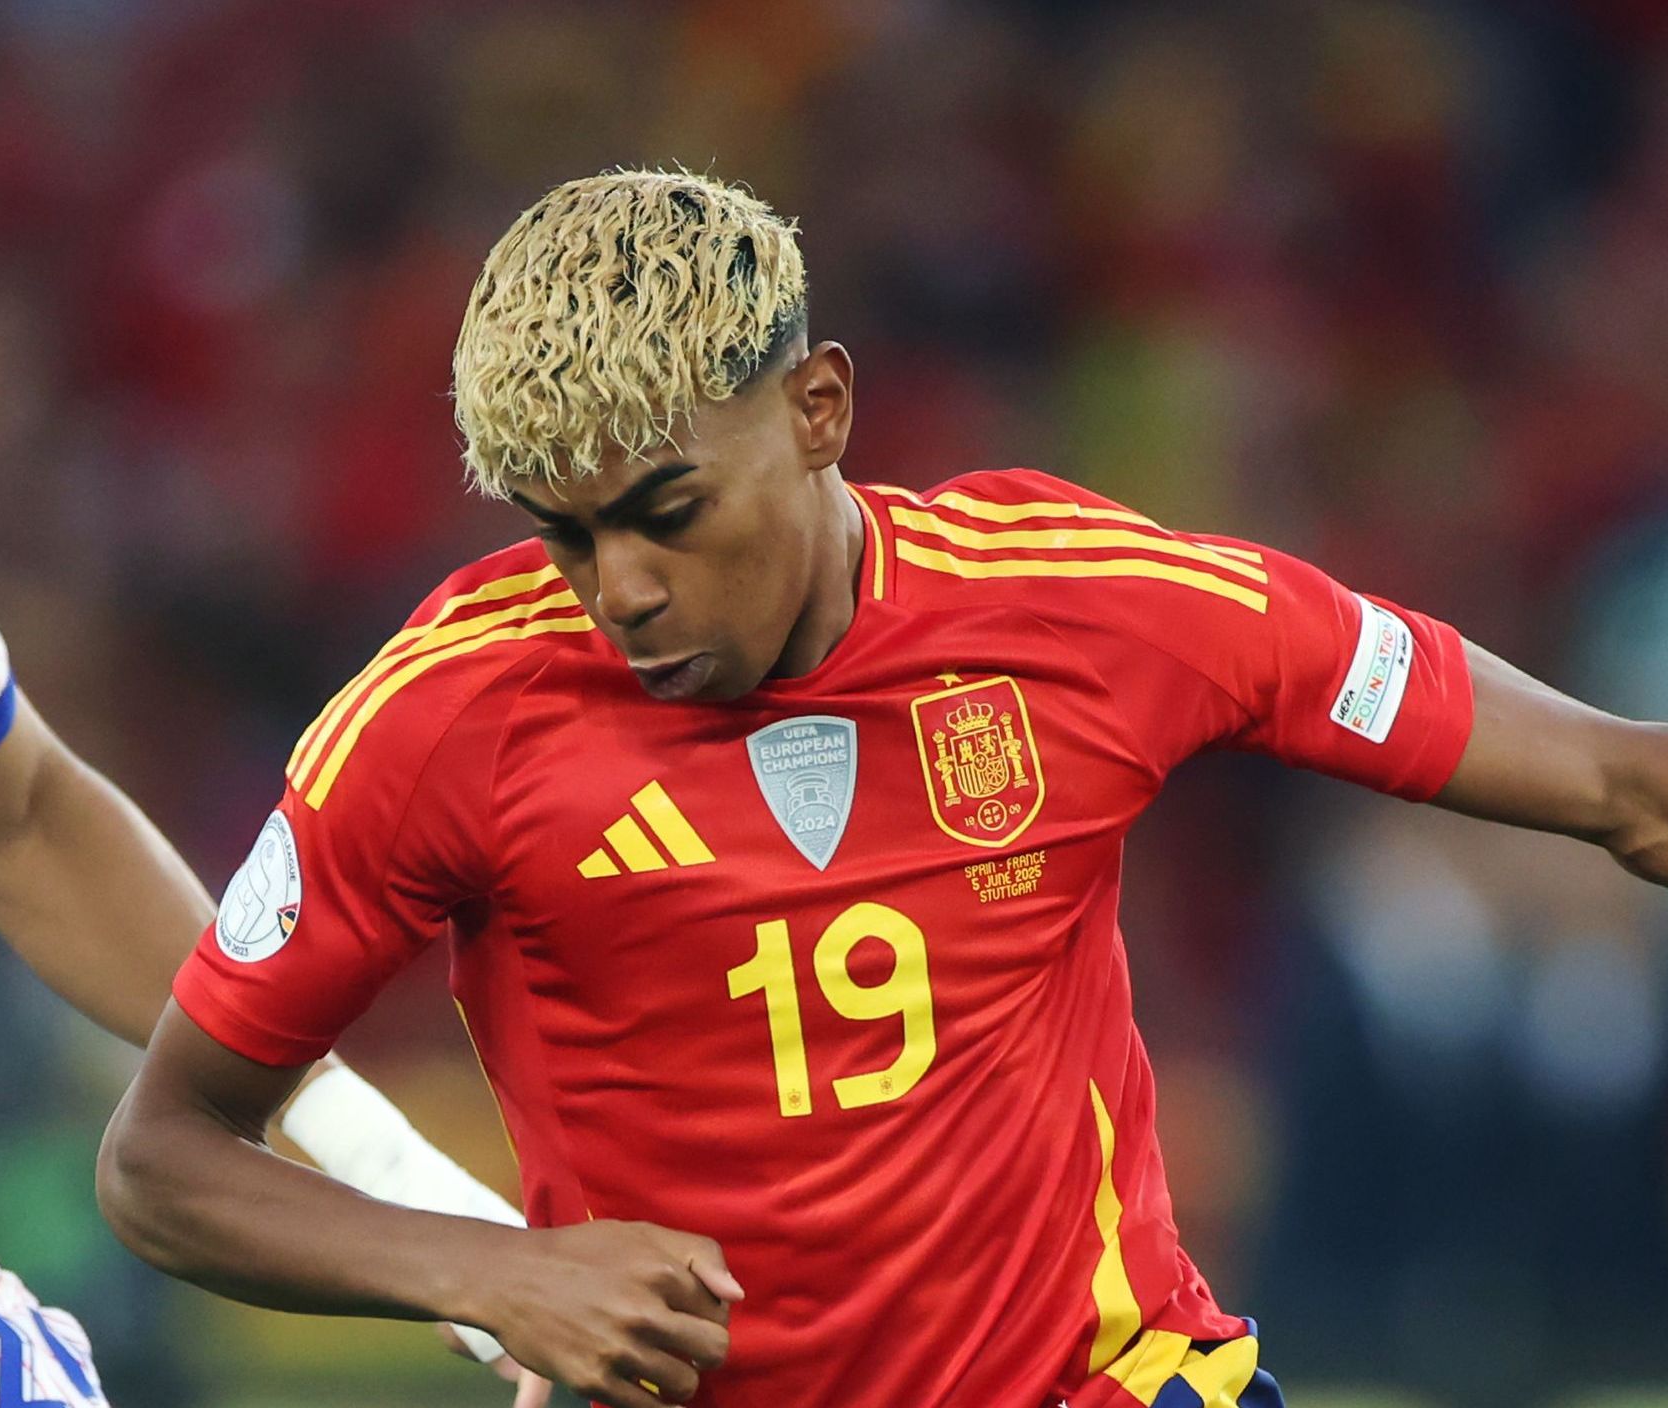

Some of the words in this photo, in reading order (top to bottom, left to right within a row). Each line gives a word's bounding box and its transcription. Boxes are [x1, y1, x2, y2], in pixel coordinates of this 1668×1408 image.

[1352, 621, 1393, 729] FOUNDATION
[1337, 690, 1355, 721] UEFA
[783, 725, 818, 739] UEFA
[761, 735, 846, 760] EUROPEAN
[762, 750, 847, 774] CHAMPIONS
[795, 816, 836, 833] 2024
[964, 861, 996, 879] SPAIN
[1006, 850, 1047, 870] FRANCE
[971, 878, 980, 891] 5
[984, 872, 1012, 888] JUNE
[1015, 864, 1043, 882] 2025
[979, 879, 1038, 904] STUTTGART
[726, 901, 937, 1117] 19
